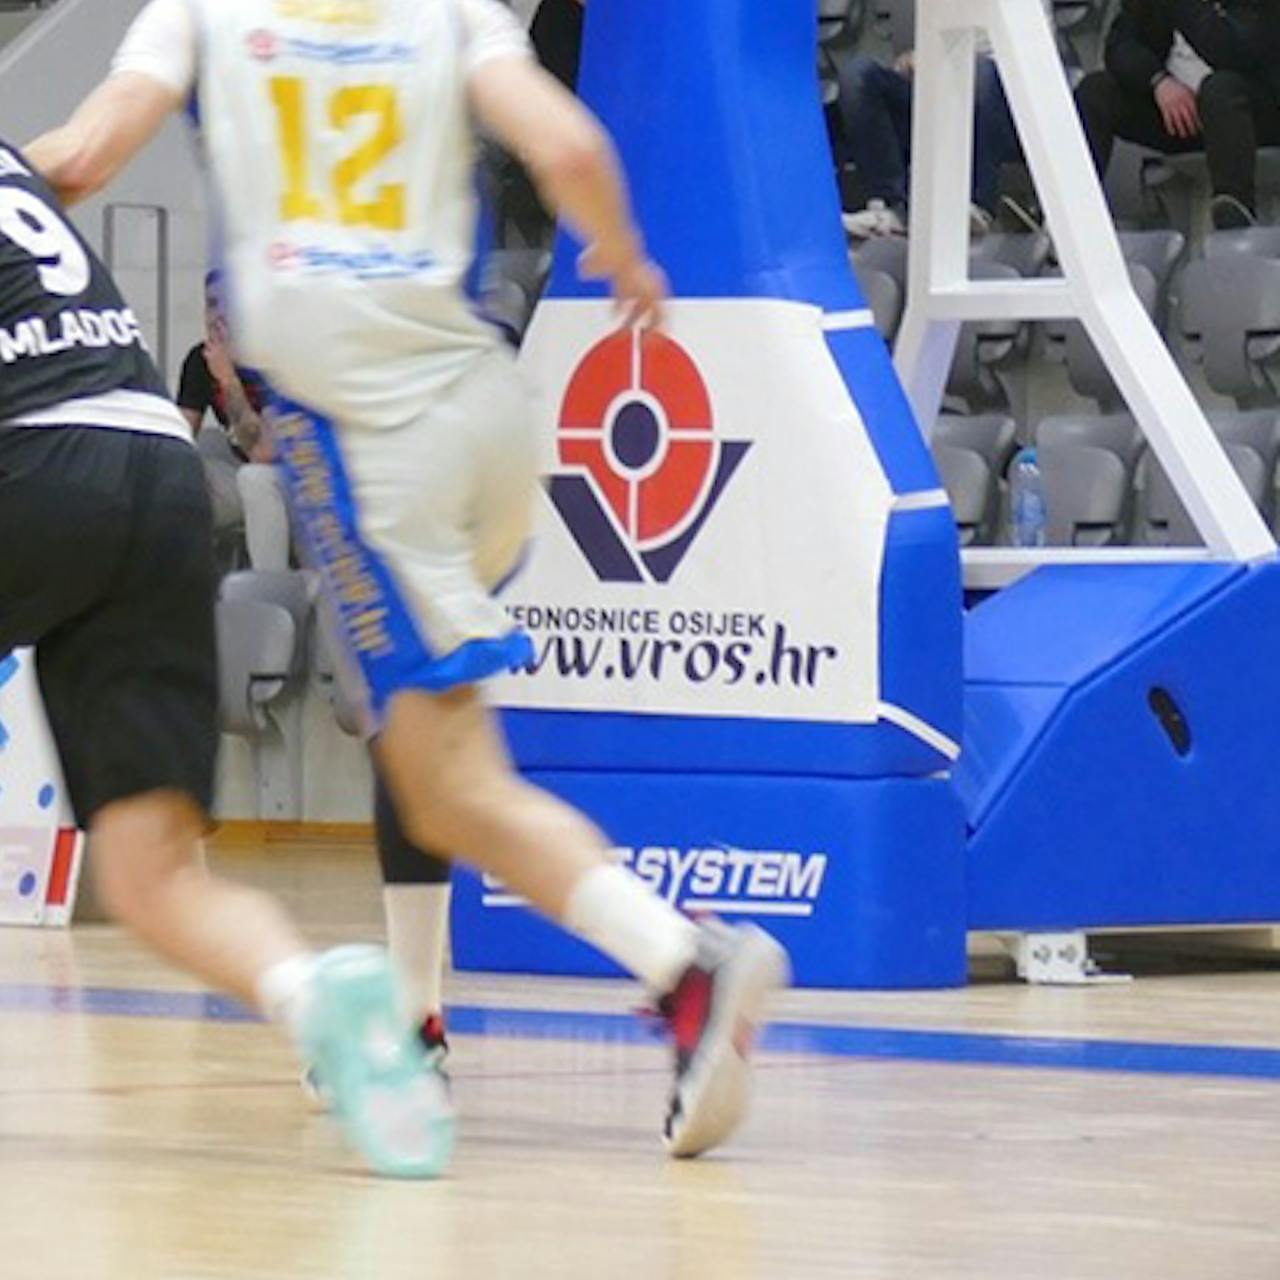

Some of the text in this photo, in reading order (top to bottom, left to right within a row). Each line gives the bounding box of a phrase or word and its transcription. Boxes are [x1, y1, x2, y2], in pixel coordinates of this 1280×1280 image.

[269, 75, 408, 230] 12
[505, 605, 766, 637] EDNOSNICE OSIJEK
